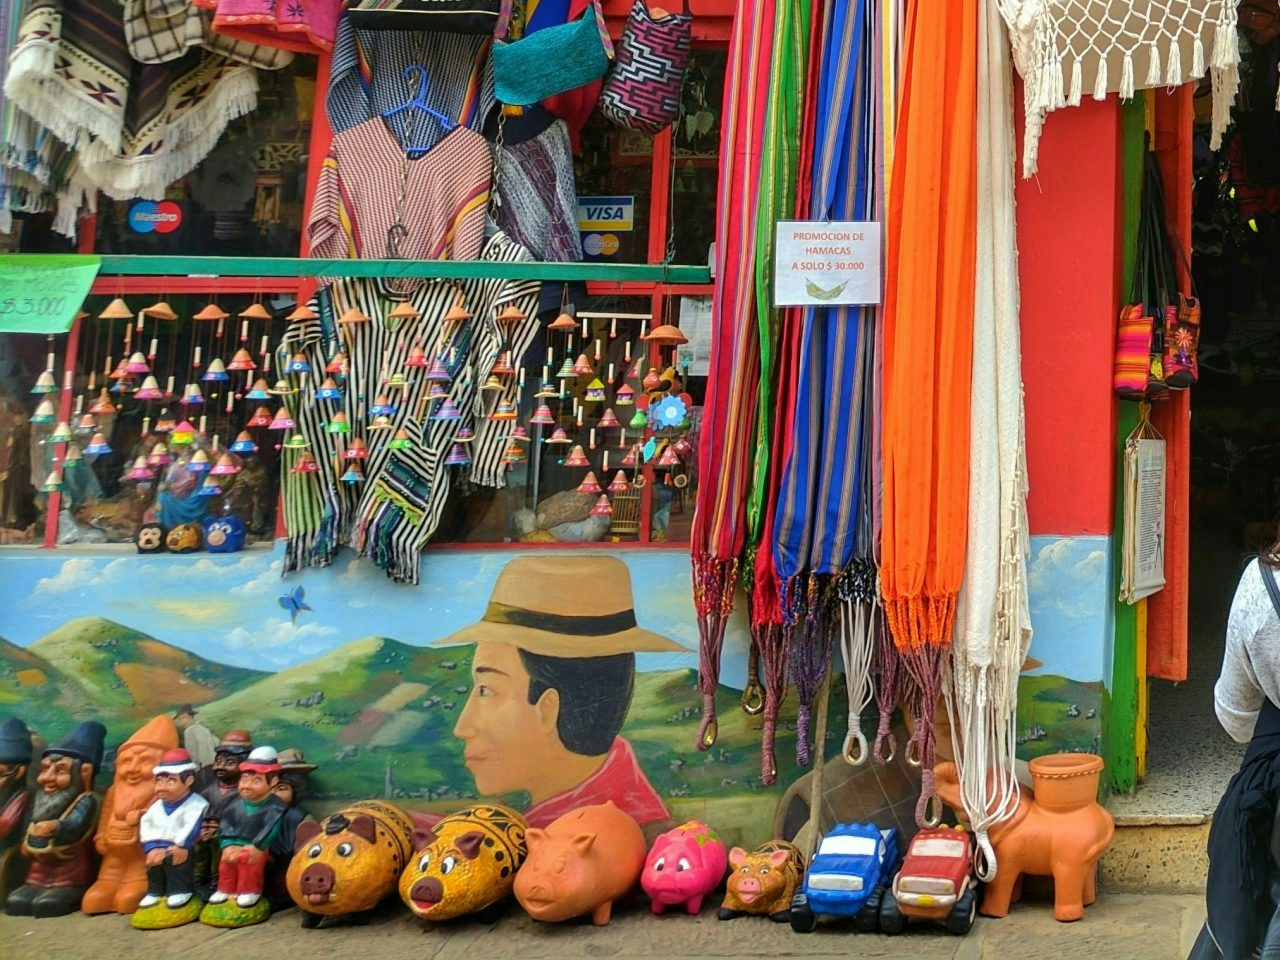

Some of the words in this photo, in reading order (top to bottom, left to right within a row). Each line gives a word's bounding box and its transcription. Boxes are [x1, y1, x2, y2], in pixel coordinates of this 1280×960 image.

[586, 207, 624, 220] VISA
[793, 233, 850, 241] PROMOCION
[852, 233, 864, 241] DE
[805, 247, 852, 255] HAMACAS
[791, 262, 799, 270] A
[800, 262, 825, 270] SOLO
[827, 261, 832, 272] $
